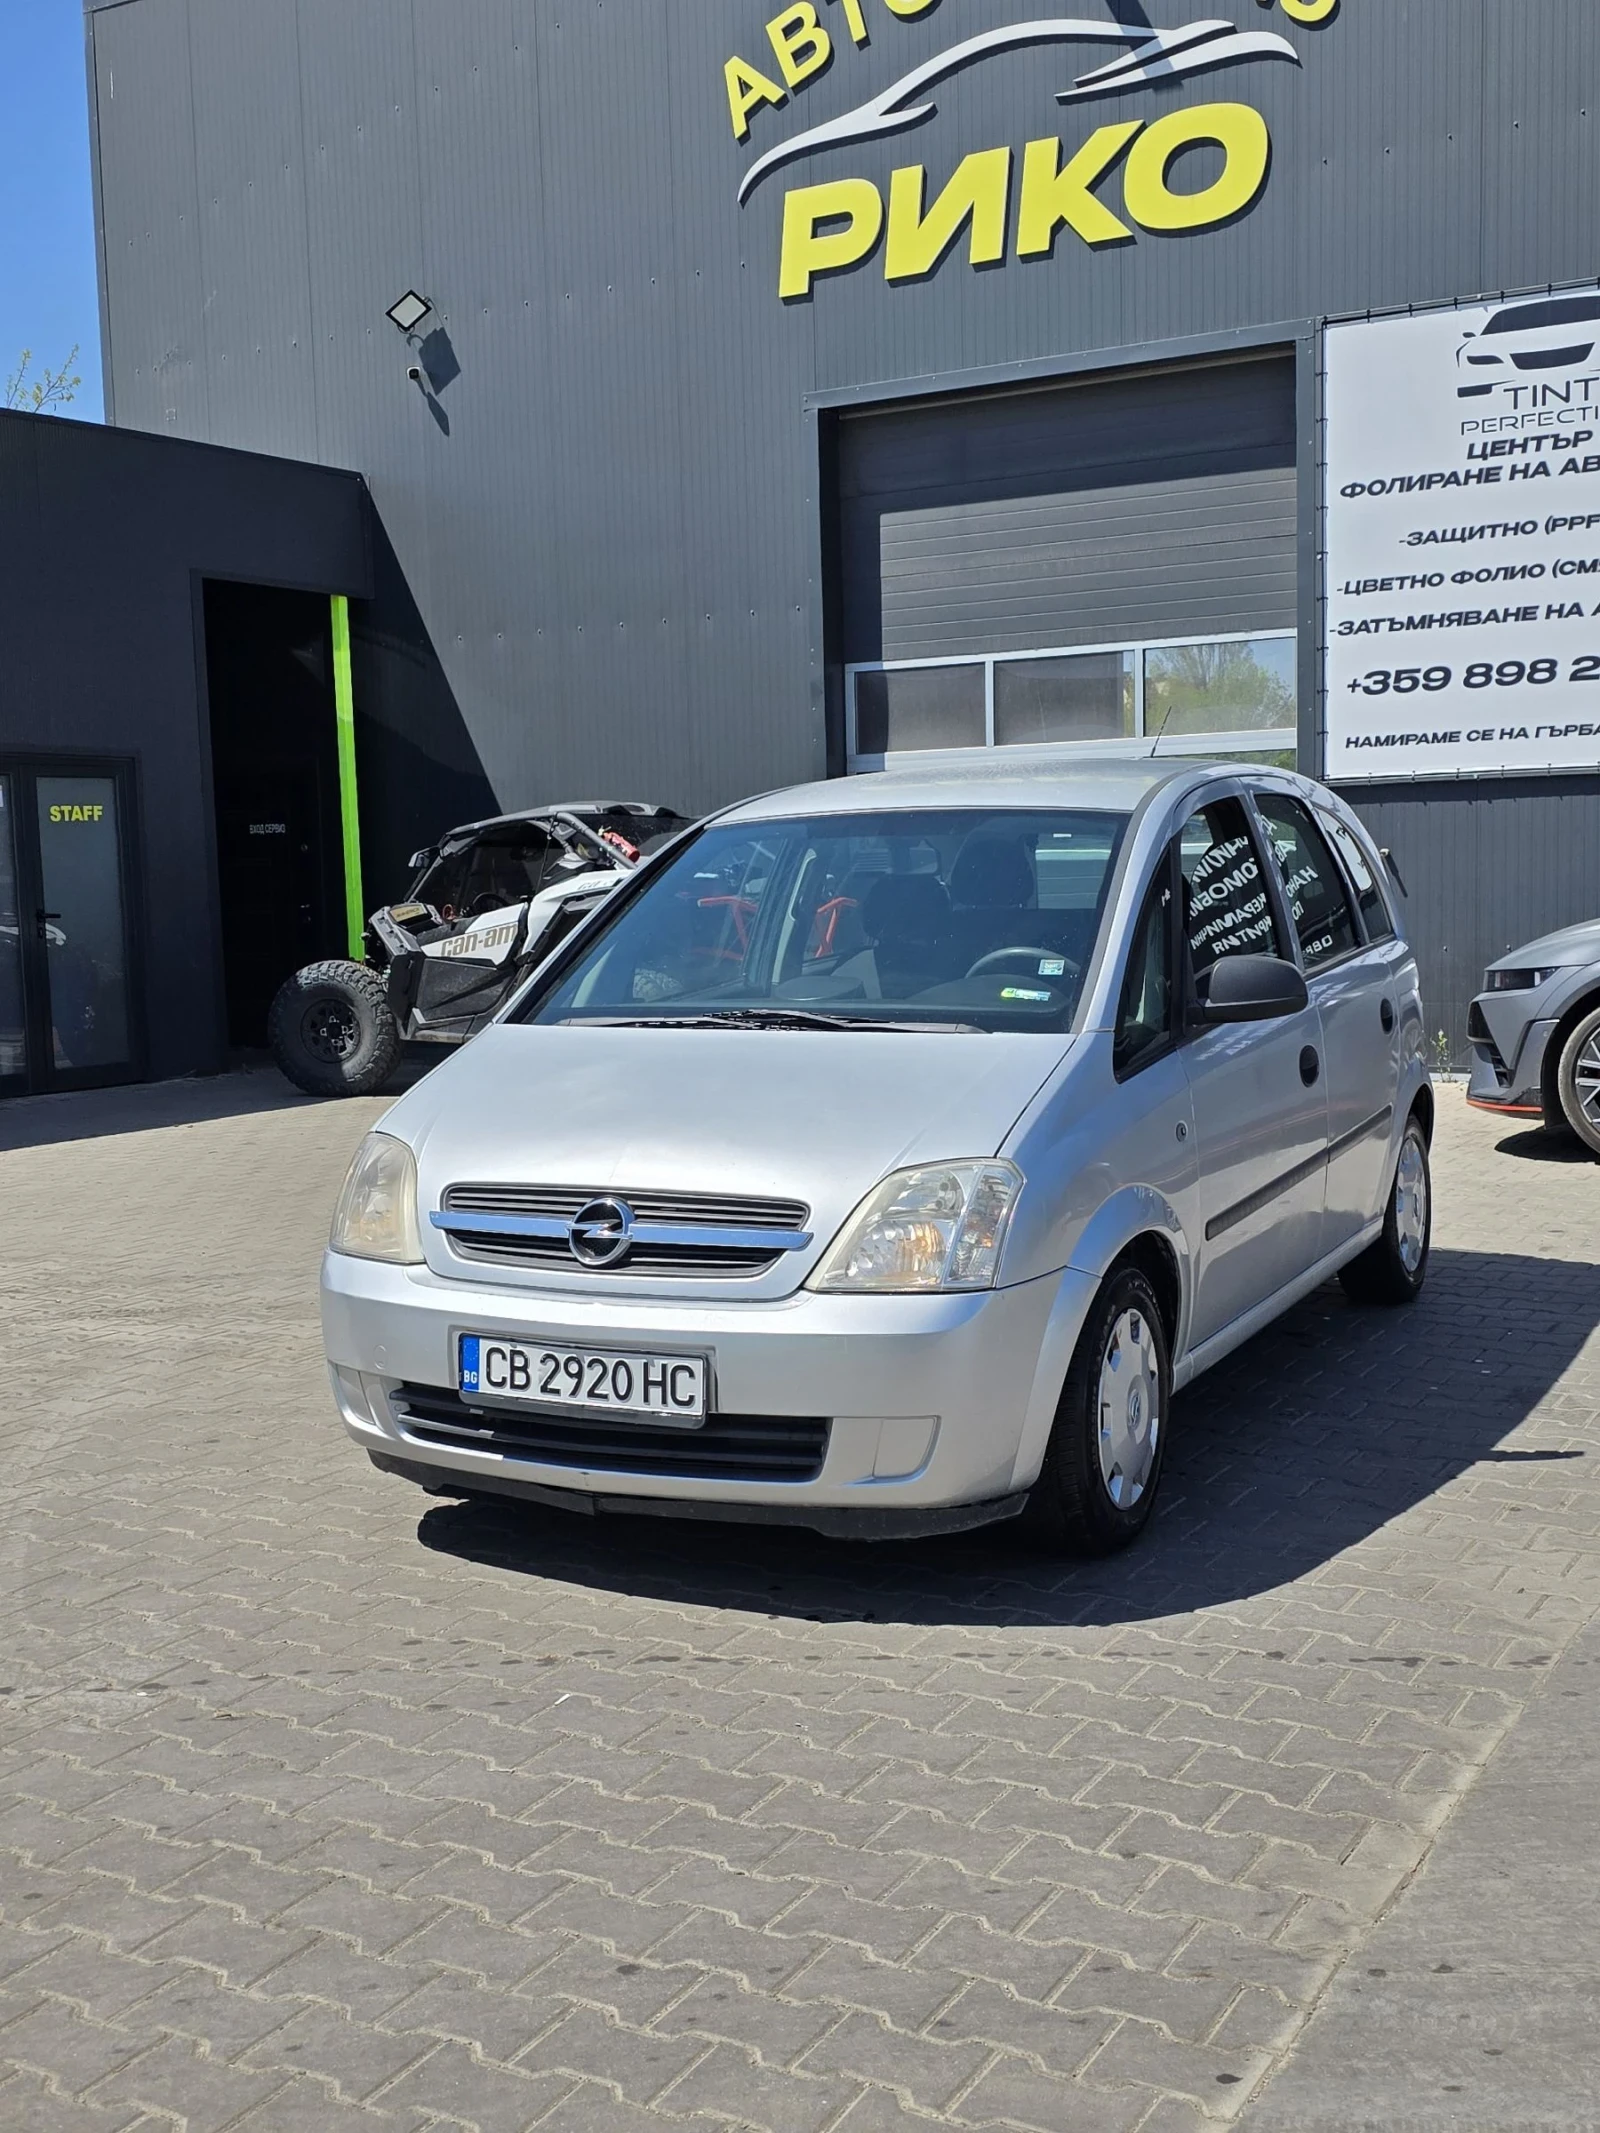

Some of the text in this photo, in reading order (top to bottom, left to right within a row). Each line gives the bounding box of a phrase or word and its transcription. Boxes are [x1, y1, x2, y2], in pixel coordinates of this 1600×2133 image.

[779, 102, 1268, 298] РИКО
[1503, 377, 1600, 410] TINT
[1467, 430, 1593, 461] ЦЕНТЪР
[1340, 465, 1503, 498] ФОЛИРАНЕ
[1509, 461, 1551, 481] НА
[1336, 558, 1600, 596] -ЦВЕТНО ФОЛИО (СМ
[1545, 602, 1584, 620] НА
[1347, 666, 1452, 695] +359
[1463, 658, 1558, 689] 898
[1345, 731, 1461, 749] НАМИРАМЕ
[1466, 728, 1495, 742] СЕ
[1499, 727, 1529, 741] НА
[50, 805, 103, 822] STAFF
[441, 921, 519, 957] can-am
[464, 1370, 477, 1384] BG
[486, 1346, 696, 1406] CB 2920 HC
